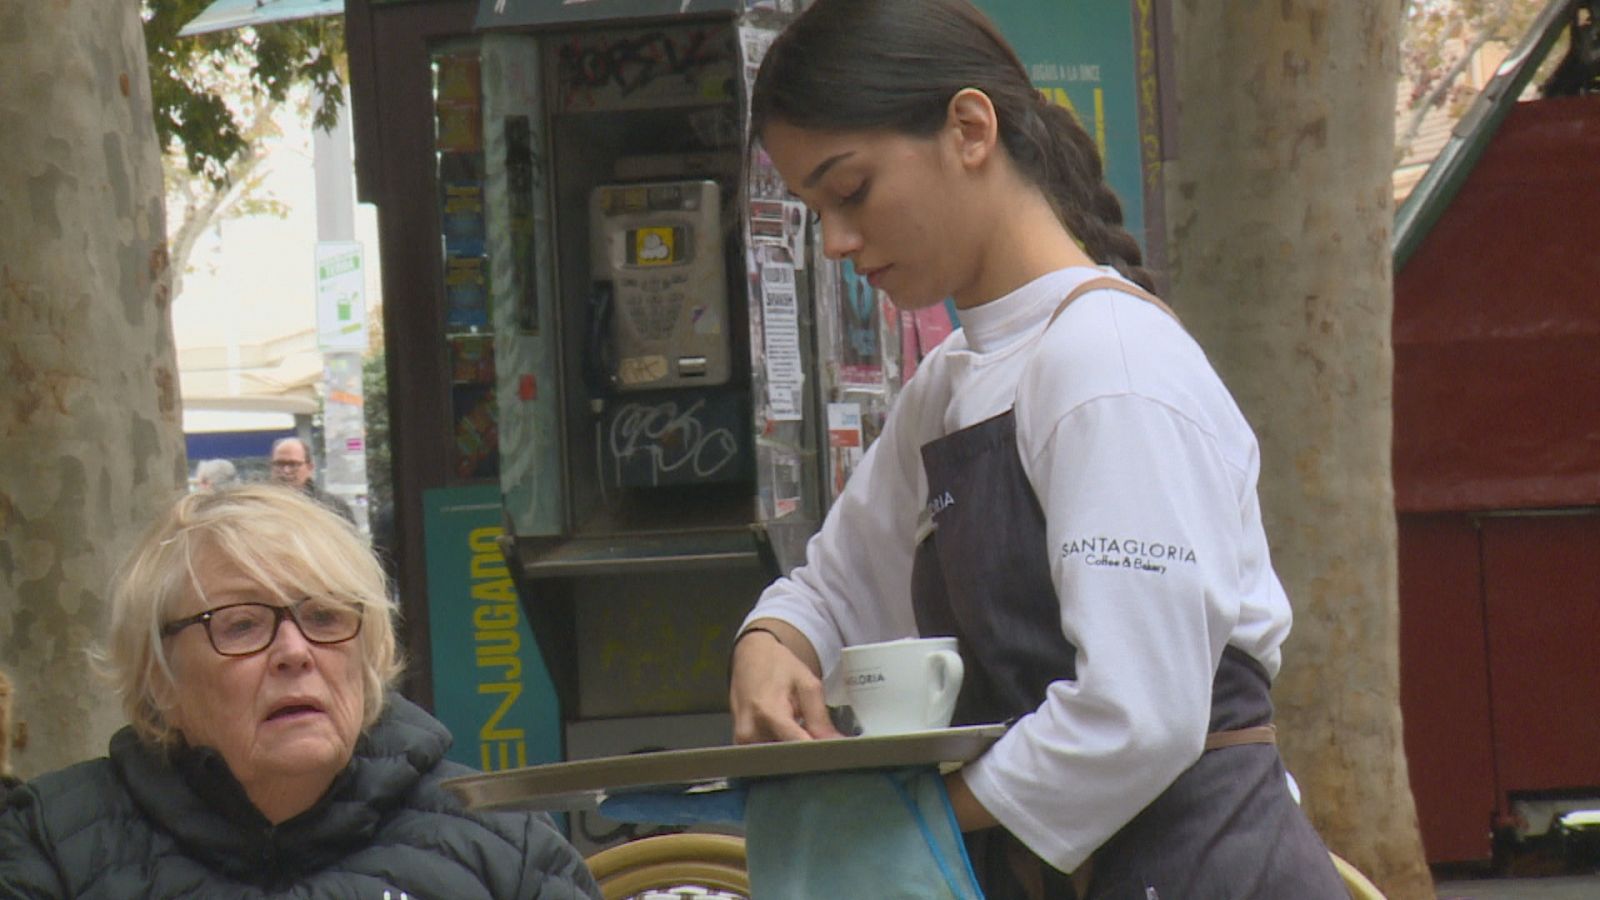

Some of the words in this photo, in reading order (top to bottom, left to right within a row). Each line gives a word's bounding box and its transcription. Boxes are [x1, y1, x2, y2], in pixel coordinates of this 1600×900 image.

[1061, 537, 1197, 563] SANTAGLORIA
[1085, 554, 1119, 566] Coffee
[1122, 556, 1131, 568] &
[1133, 558, 1167, 574] Bakery
